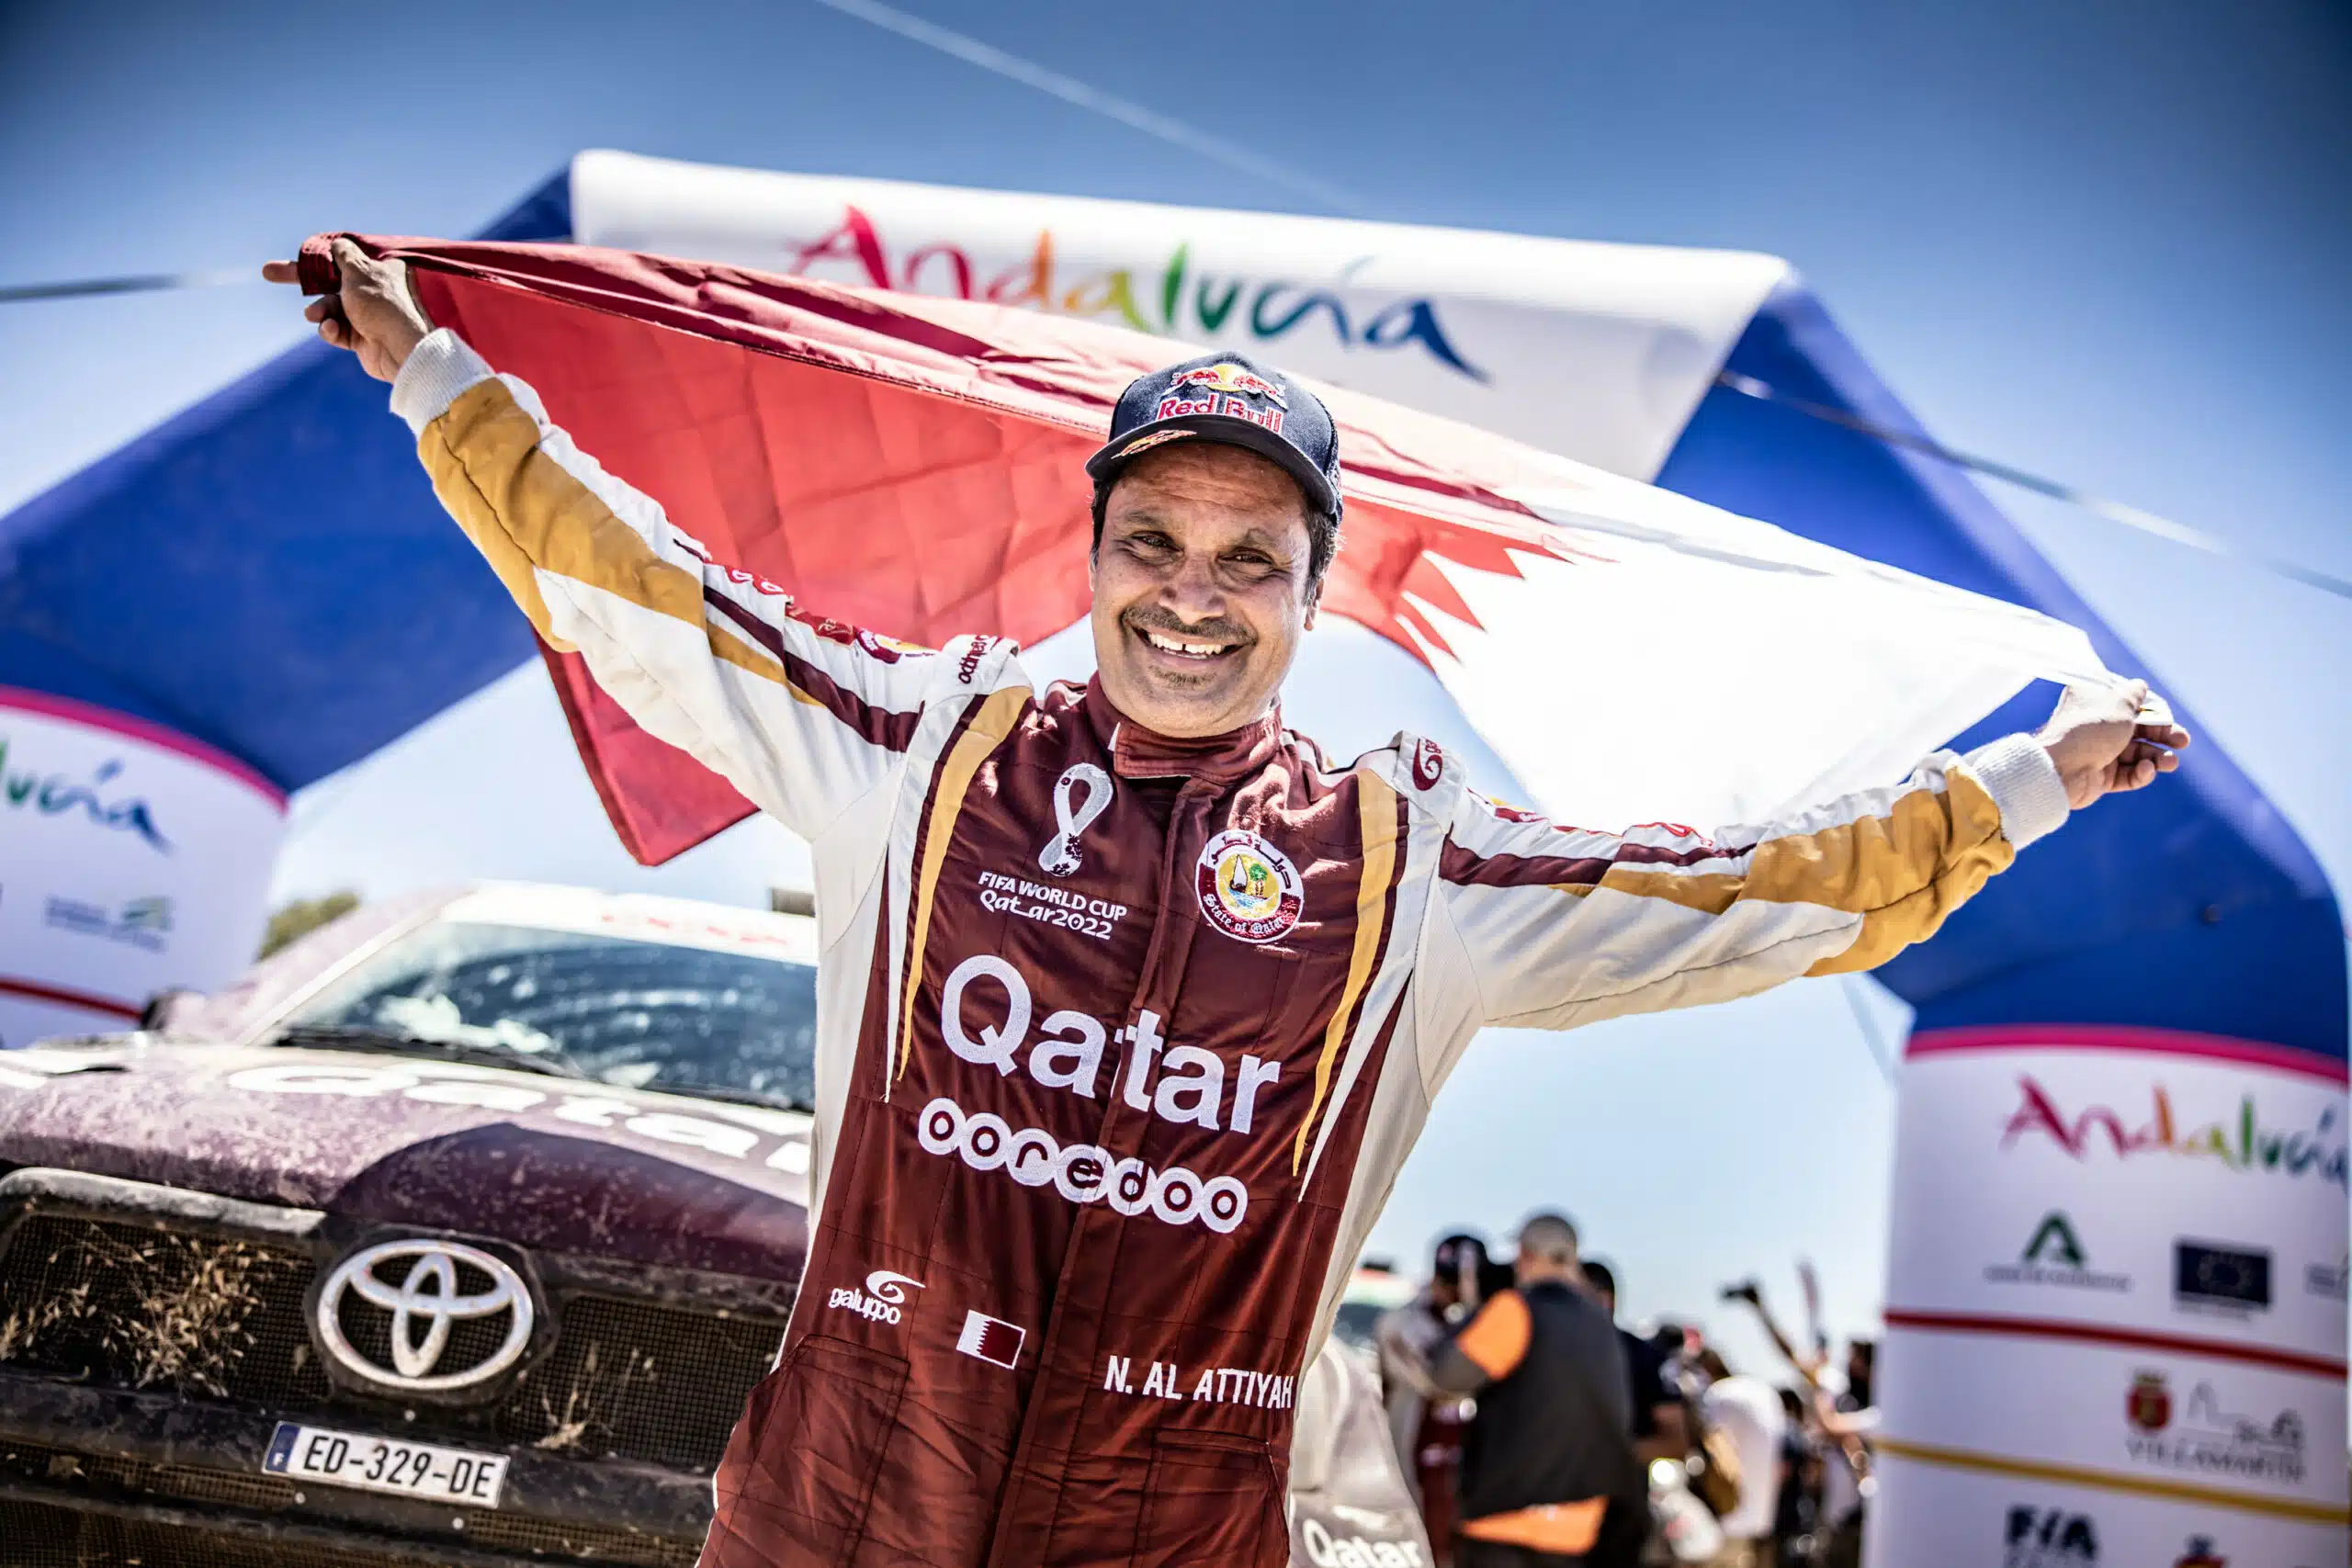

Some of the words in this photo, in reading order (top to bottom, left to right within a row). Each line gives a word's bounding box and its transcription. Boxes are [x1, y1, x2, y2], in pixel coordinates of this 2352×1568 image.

[1156, 392, 1220, 422] Red
[1224, 397, 1284, 435] Bull
[978, 872, 1016, 894] FIFA
[1018, 880, 1087, 910] WORLD
[1089, 900, 1127, 921] CUP
[1203, 893, 1232, 926] State
[1234, 921, 1248, 932] of
[941, 954, 1282, 1134] Qatar
[923, 1103, 1243, 1227] ooredoo
[829, 1288, 901, 1325] galuppo
[1103, 1355, 1133, 1394] N.
[1142, 1361, 1183, 1401] AL
[1193, 1368, 1295, 1409] ATTIYAH
[303, 1435, 496, 1498] ED-329-DE
[1303, 1518, 1422, 1568] Qatar
[2005, 1503, 2101, 1560] FIA
